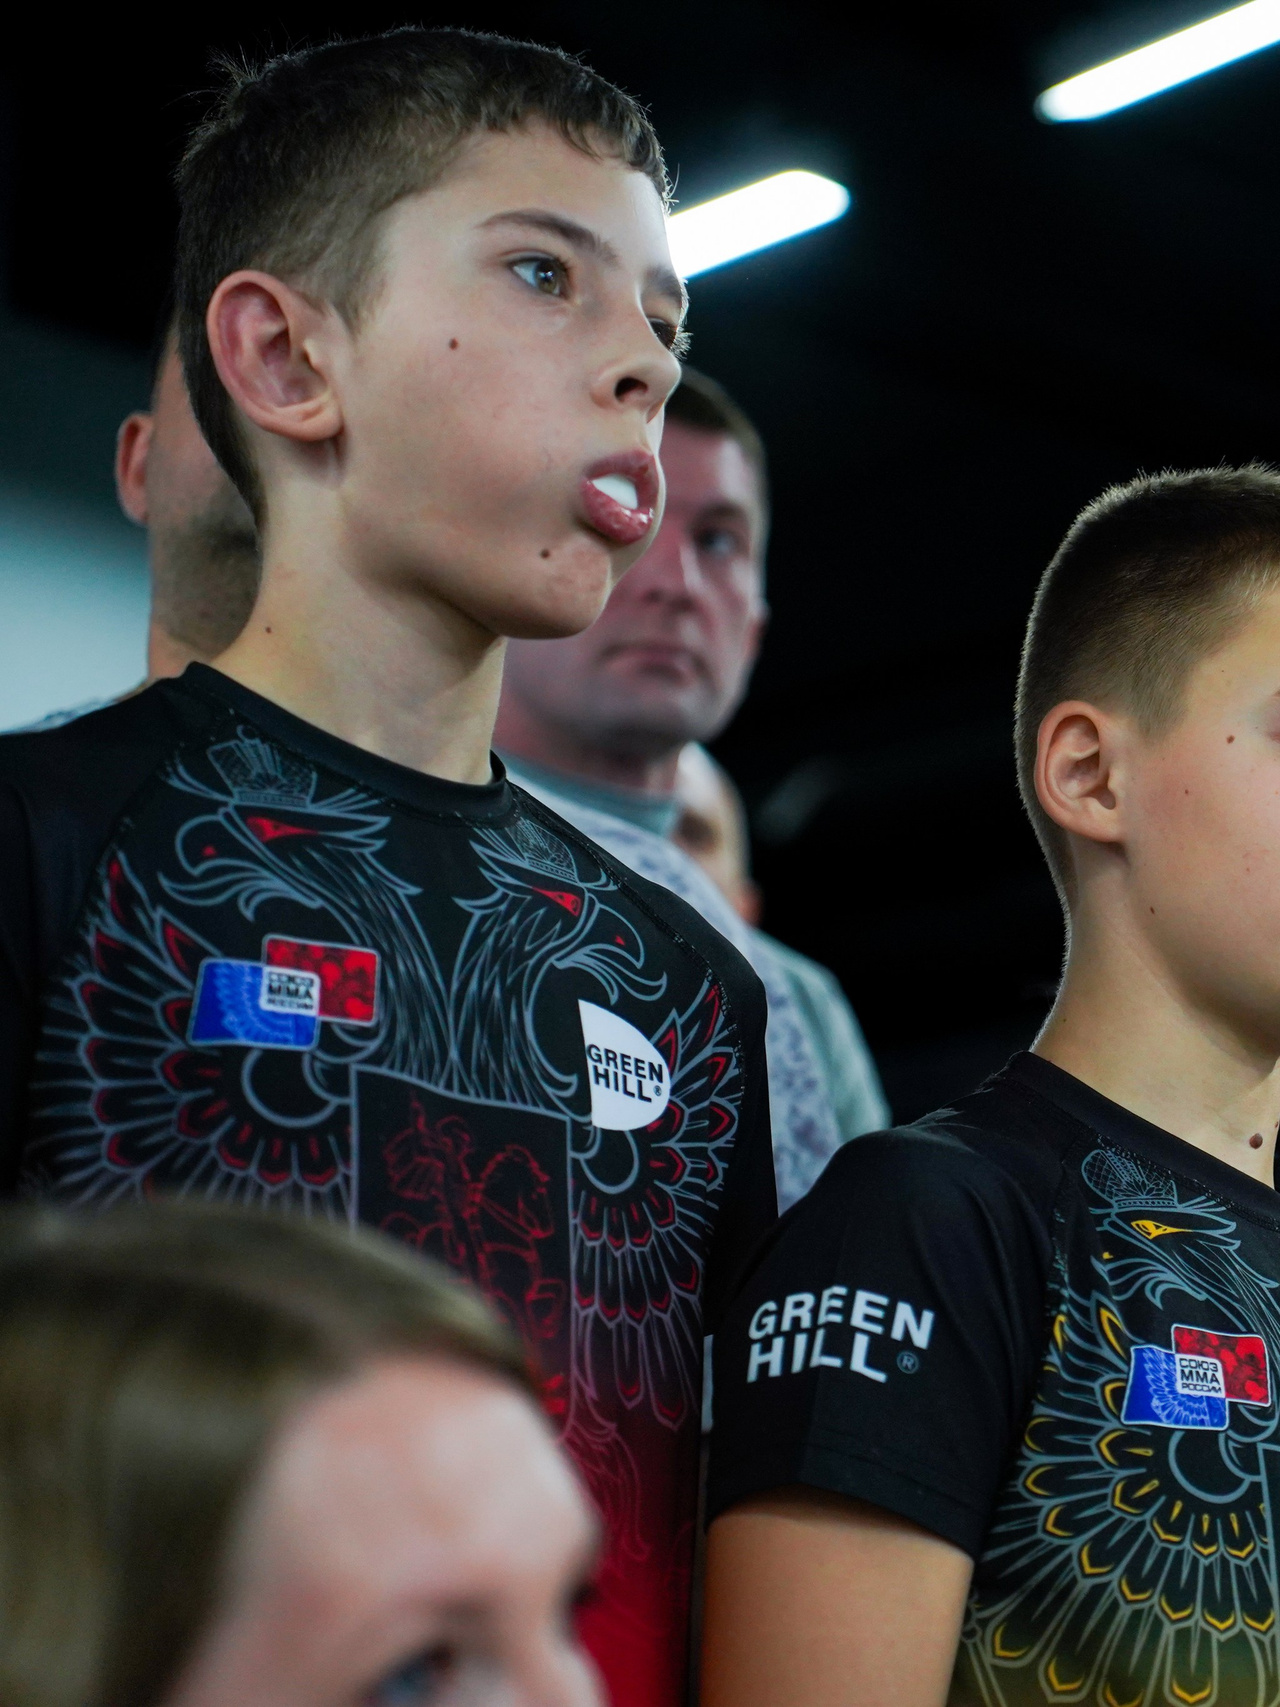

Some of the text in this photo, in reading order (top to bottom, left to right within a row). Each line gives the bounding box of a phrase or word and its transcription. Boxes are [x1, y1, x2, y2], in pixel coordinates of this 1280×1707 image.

[268, 983, 313, 998] ММА
[586, 1043, 664, 1084] GREEN
[592, 1064, 653, 1103] HILL
[748, 1284, 935, 1350] GREEN
[747, 1328, 888, 1384] HILL
[1179, 1357, 1219, 1372] СОЮЗ
[1180, 1369, 1221, 1386] ММА
[1181, 1382, 1222, 1394] РОССИИ
